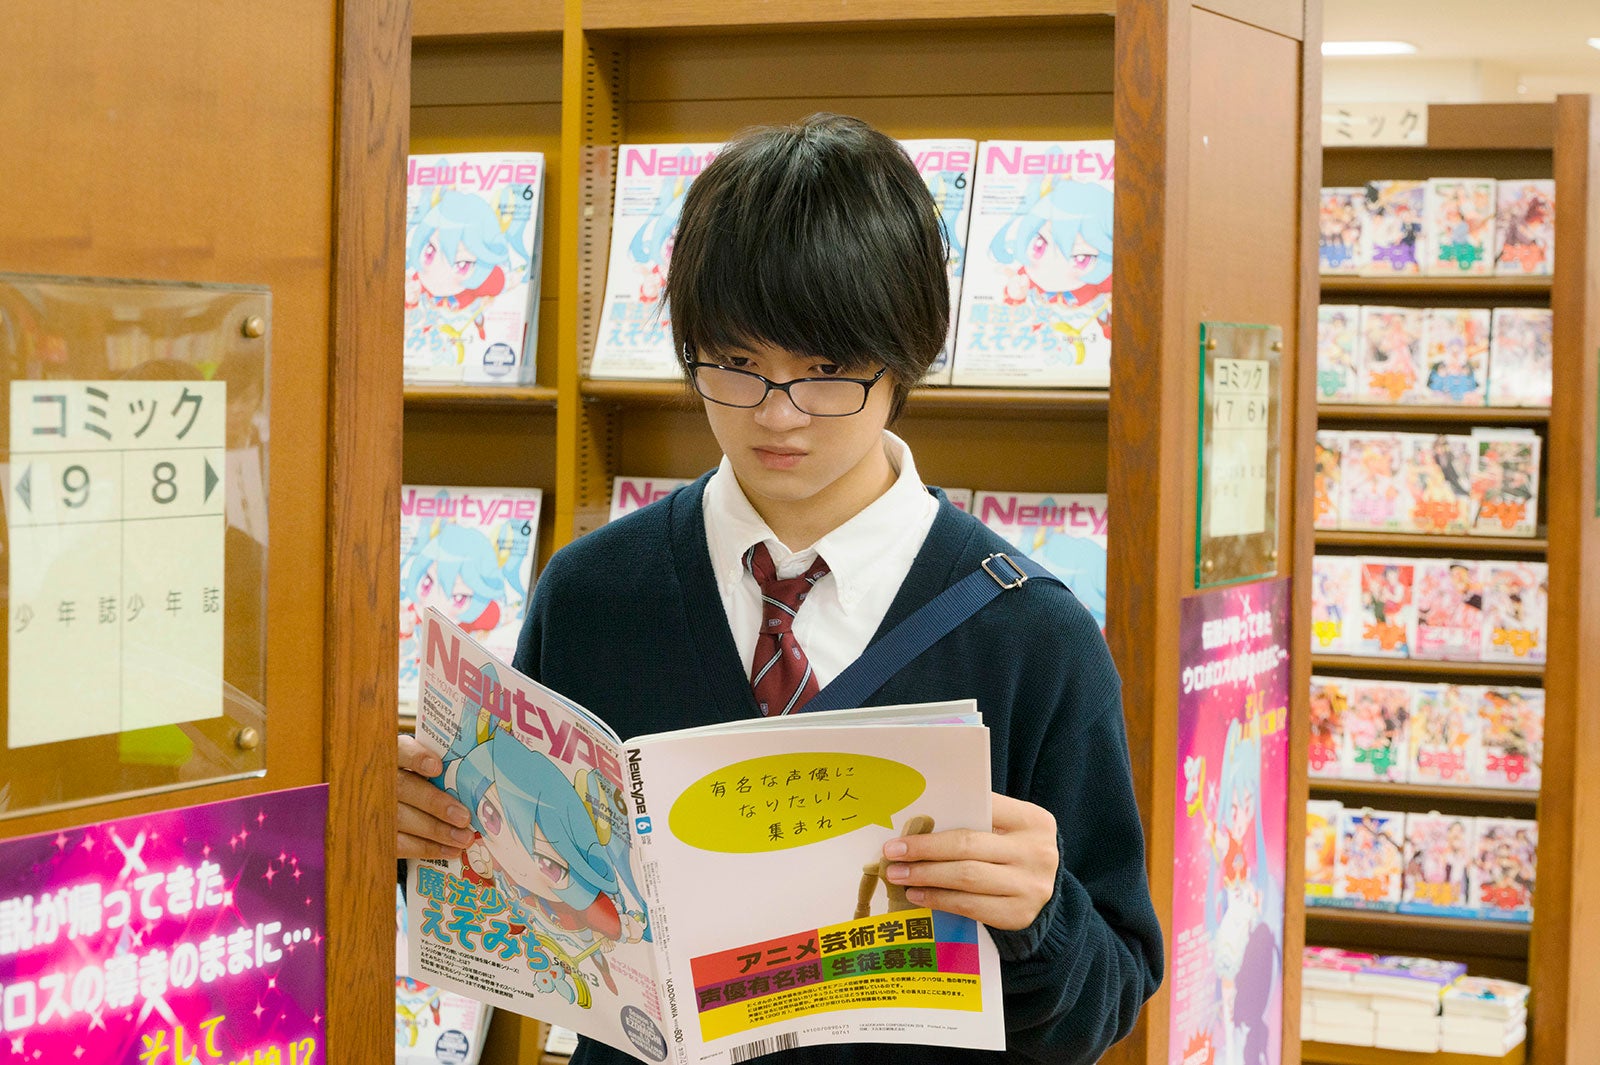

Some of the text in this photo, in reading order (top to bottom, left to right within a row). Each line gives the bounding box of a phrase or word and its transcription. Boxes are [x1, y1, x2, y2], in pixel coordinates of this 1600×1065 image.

[985, 147, 1115, 180] Newty
[523, 185, 534, 200] 6
[954, 173, 966, 189] 6
[1219, 362, 1262, 388] コミック
[32, 387, 204, 440] コミック
[1226, 401, 1255, 422] 7 6
[62, 462, 177, 508] 9 8
[521, 520, 531, 536] 6
[981, 496, 1107, 535] Newty
[15, 587, 220, 633] 少年誌 少年誌
[426, 618, 625, 791] Newtype
[627, 749, 647, 815] Newtype
[710, 766, 855, 798] 有名な声優に
[612, 788, 629, 817] 6
[739, 788, 860, 818] なりたい人
[637, 822, 650, 831] 6
[768, 814, 858, 841] 集まれー
[417, 865, 535, 931] 魔法少女
[421, 899, 552, 973] えぞみち
[737, 916, 934, 974] アニメ芸術学園
[552, 956, 590, 981] Season
[589, 972, 600, 987] 3
[698, 960, 822, 1009] 声優有名科
[831, 947, 934, 976] 生徒募集
[666, 978, 678, 1018] KADOKAWA
[673, 1029, 684, 1043] 800
